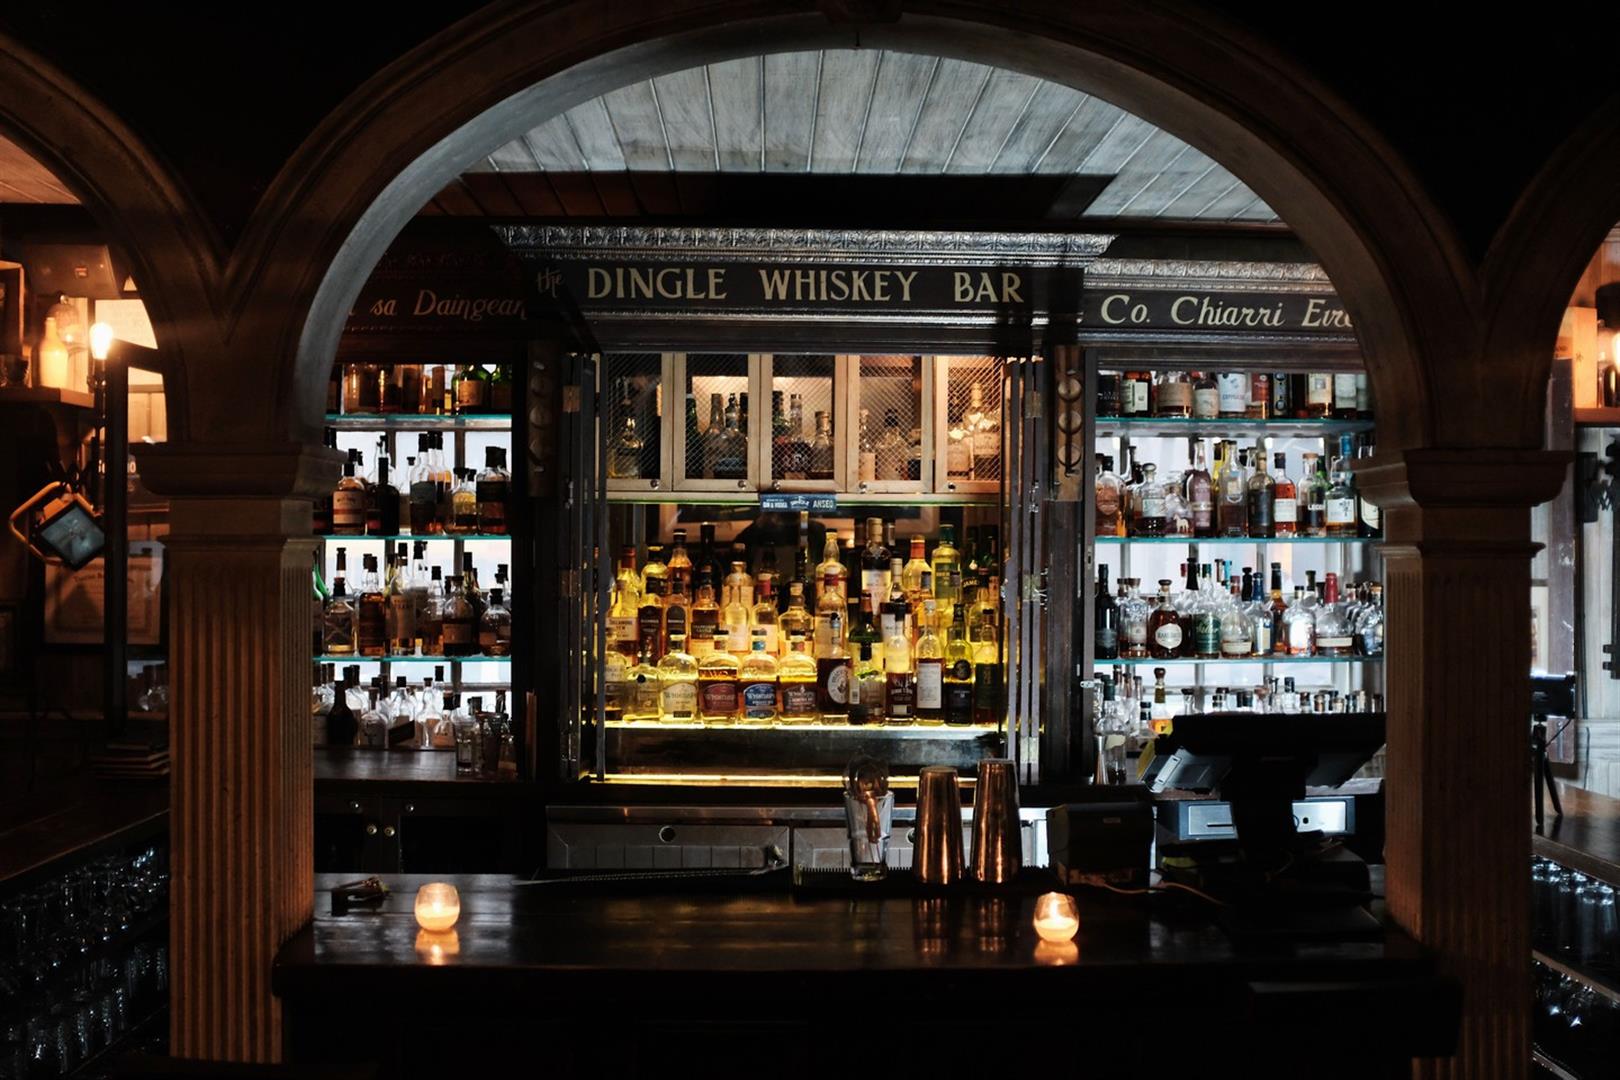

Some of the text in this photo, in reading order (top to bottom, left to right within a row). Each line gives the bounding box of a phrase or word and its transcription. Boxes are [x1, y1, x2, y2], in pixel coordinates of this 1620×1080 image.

[534, 266, 1025, 304] the DINGLE WHISKEY BAR
[369, 298, 399, 317] sa
[412, 288, 529, 323] Daingean
[1101, 294, 1151, 325] Co.
